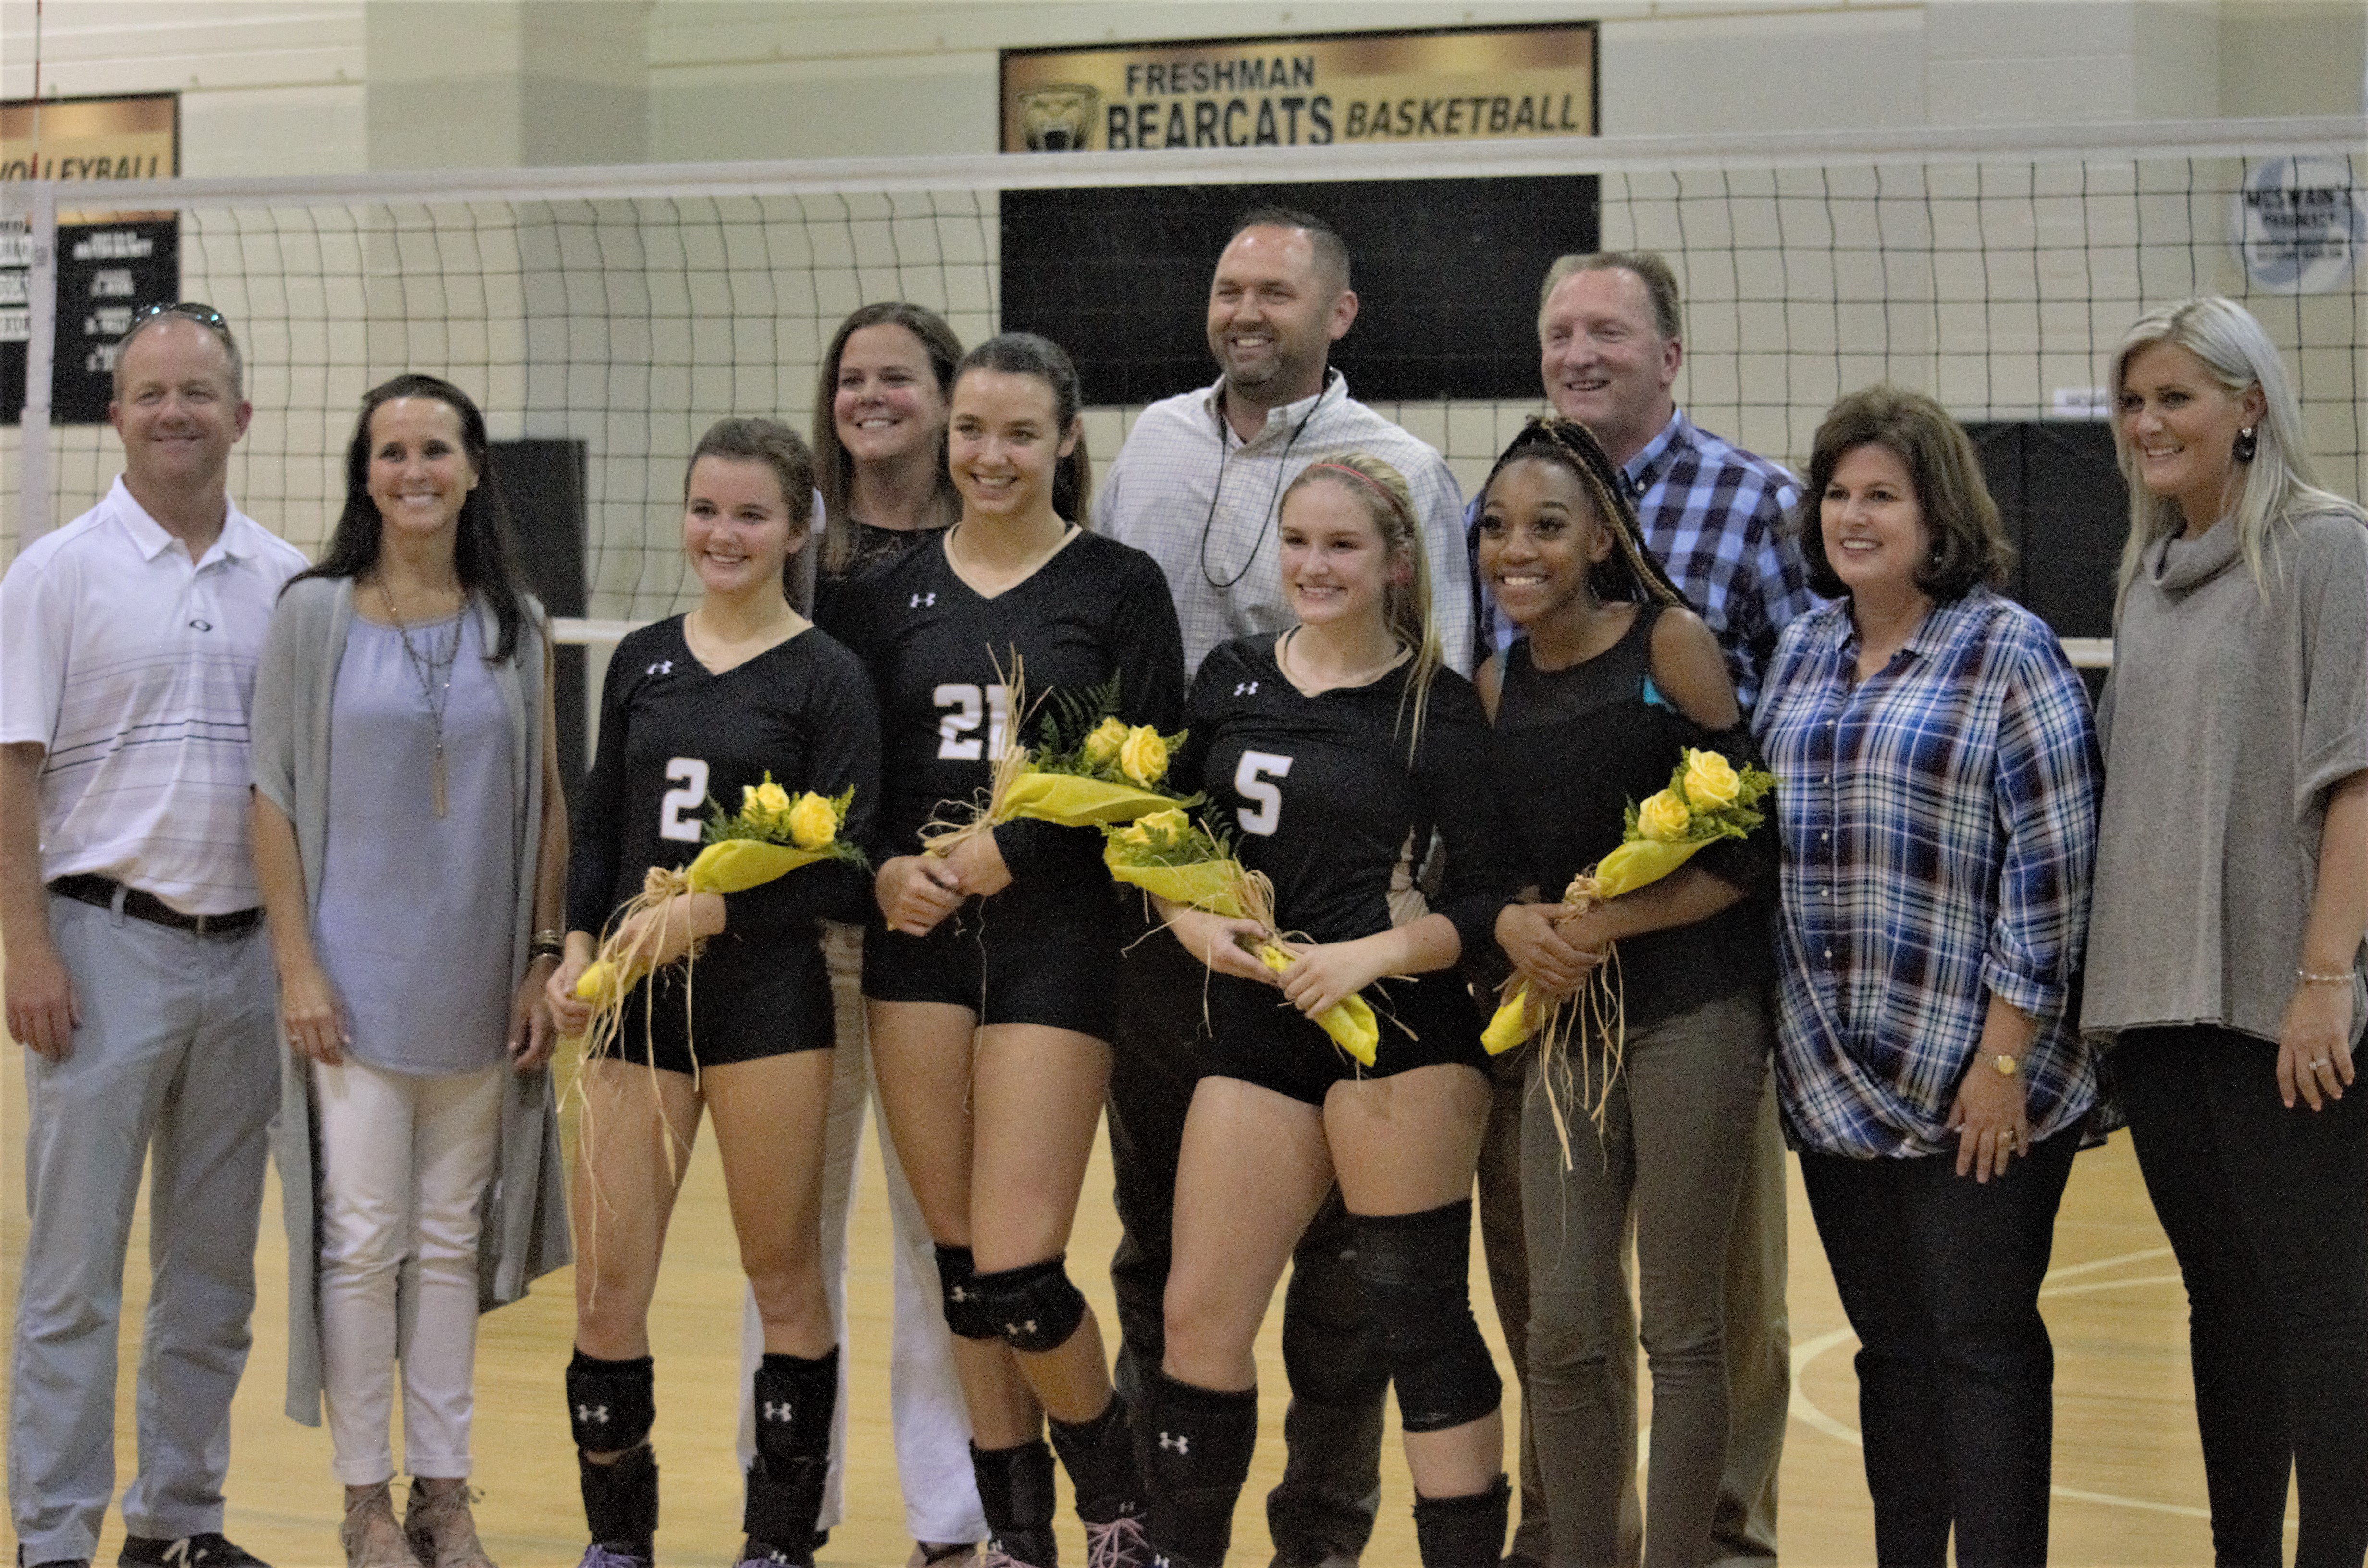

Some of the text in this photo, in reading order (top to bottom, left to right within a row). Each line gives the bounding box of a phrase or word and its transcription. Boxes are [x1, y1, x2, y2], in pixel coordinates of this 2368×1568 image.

[1126, 56, 1314, 96] FRESHMAN
[1107, 93, 1578, 150] BEARCATS BASKETBALL
[933, 683, 1012, 762] 21
[660, 757, 710, 843] 2
[1234, 750, 1294, 837] 5
